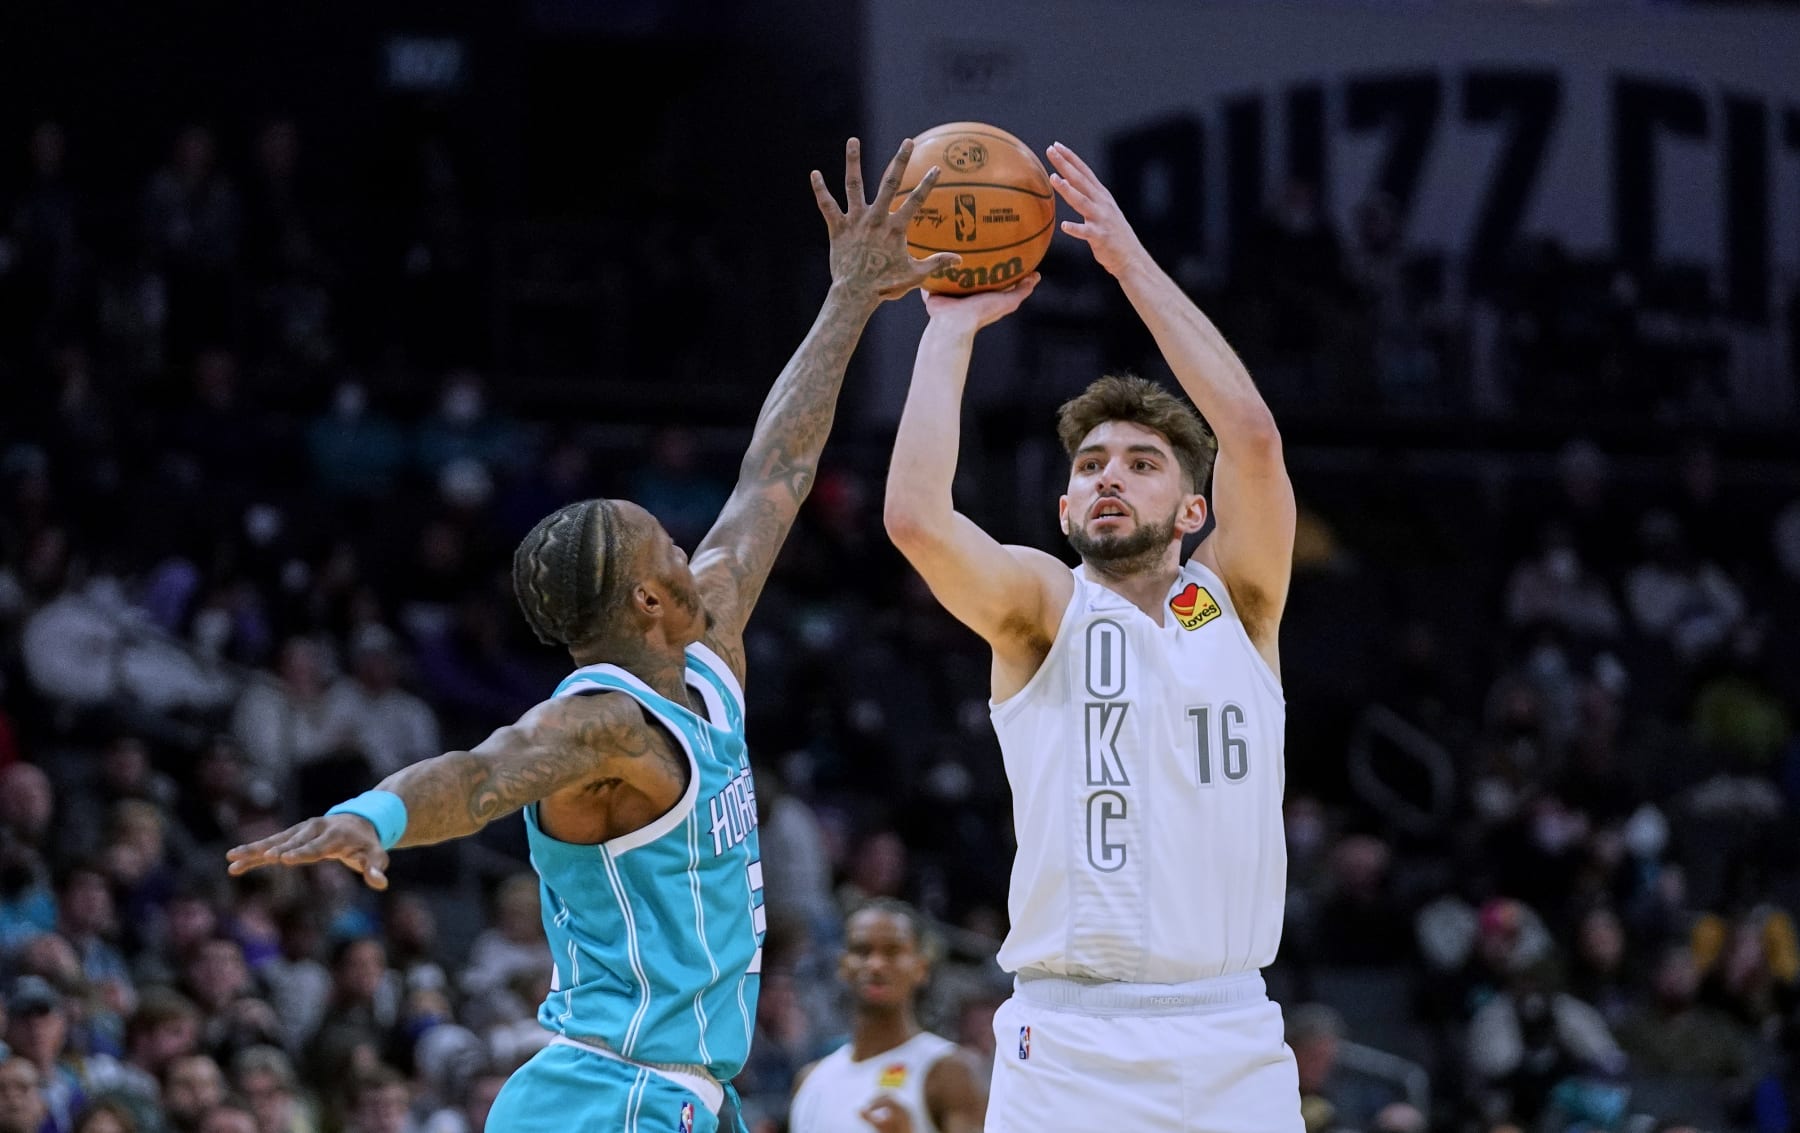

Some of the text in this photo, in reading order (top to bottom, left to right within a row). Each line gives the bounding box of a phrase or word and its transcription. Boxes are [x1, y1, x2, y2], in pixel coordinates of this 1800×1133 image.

[1608, 70, 1800, 328] CI
[1084, 618, 1131, 873] OKC
[1184, 702, 1249, 789] 16
